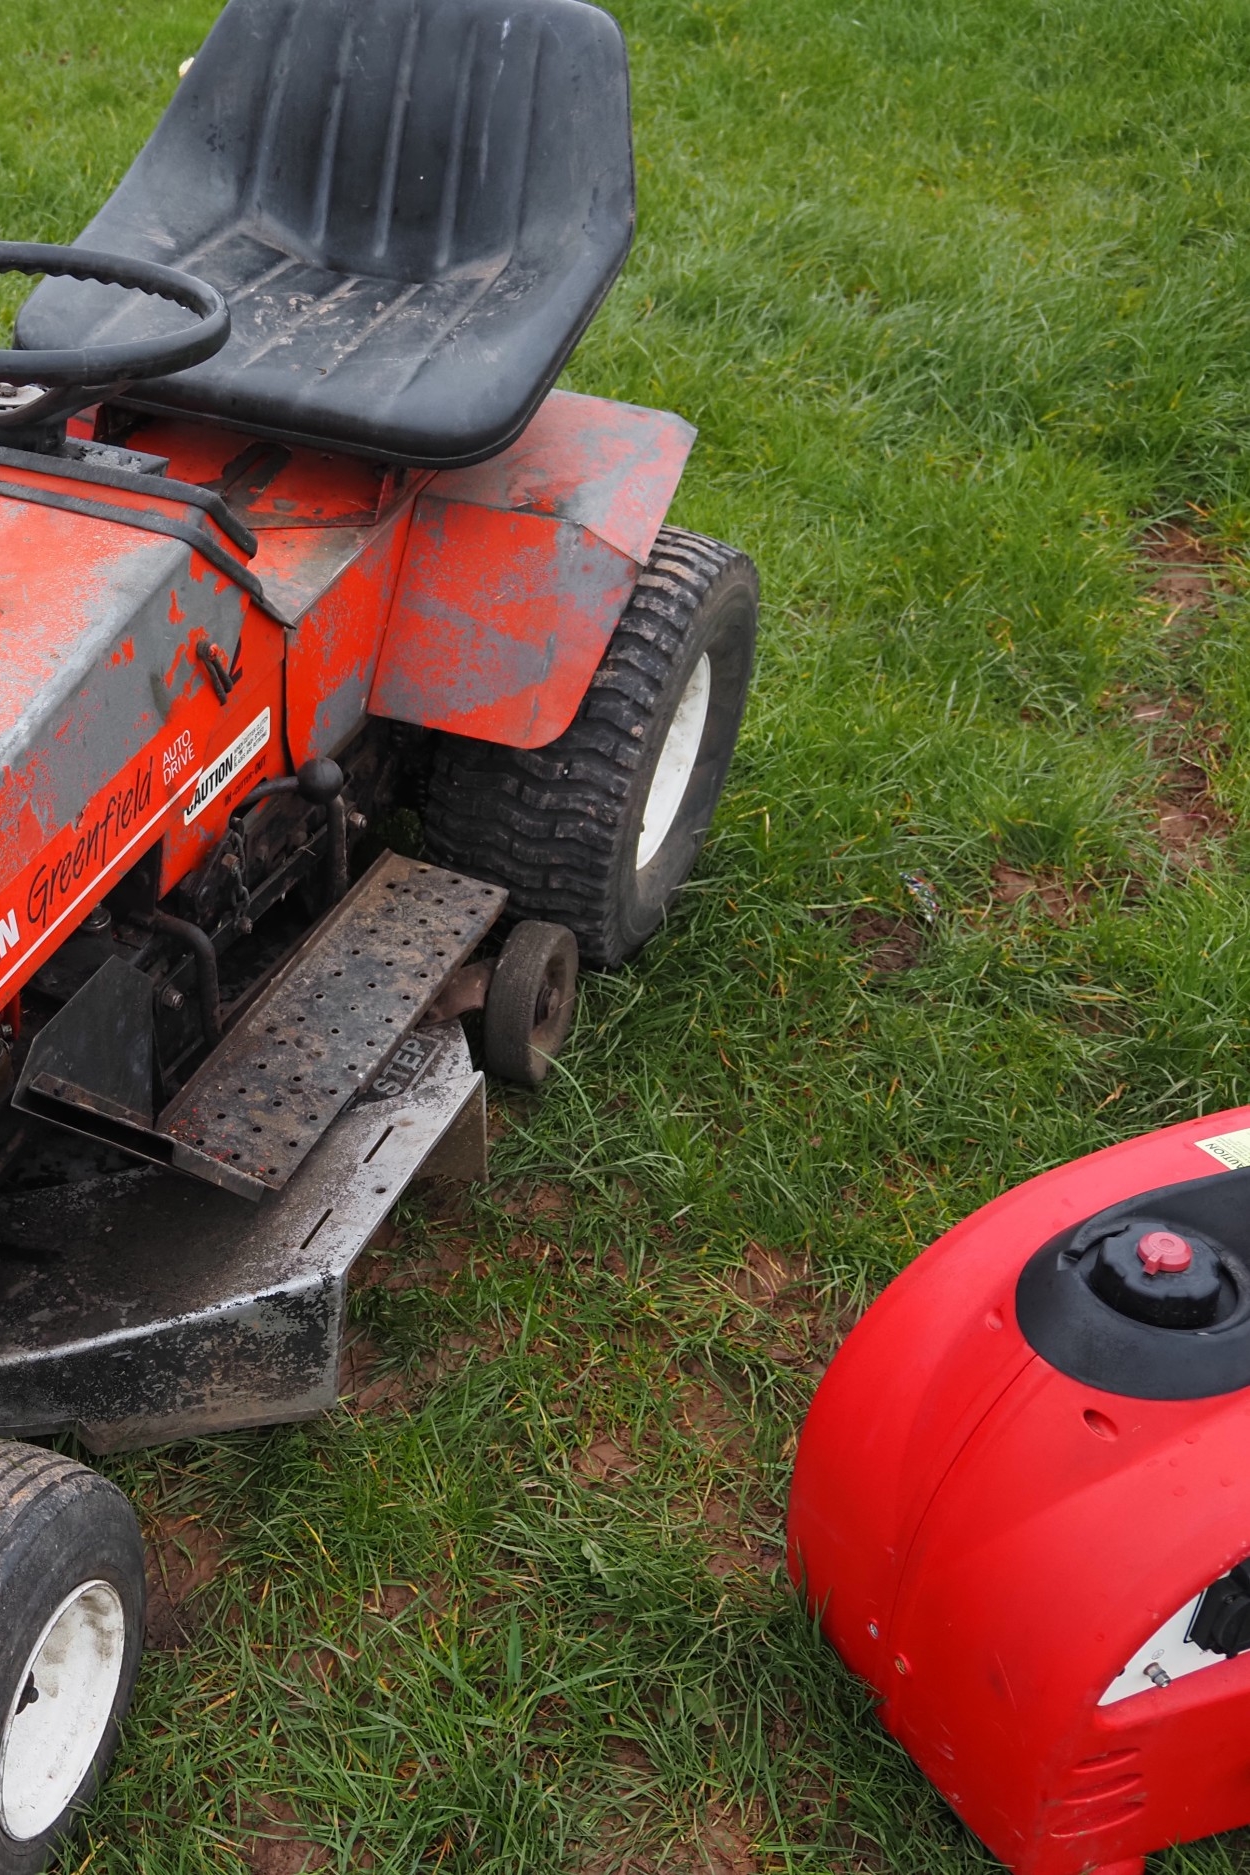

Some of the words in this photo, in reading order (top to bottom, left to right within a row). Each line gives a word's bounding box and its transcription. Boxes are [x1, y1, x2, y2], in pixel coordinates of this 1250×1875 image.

[162, 730, 192, 769] AUTO
[163, 747, 197, 787] DRIVE
[26, 755, 154, 928] Greenfield
[372, 1038, 426, 1096] STEP
